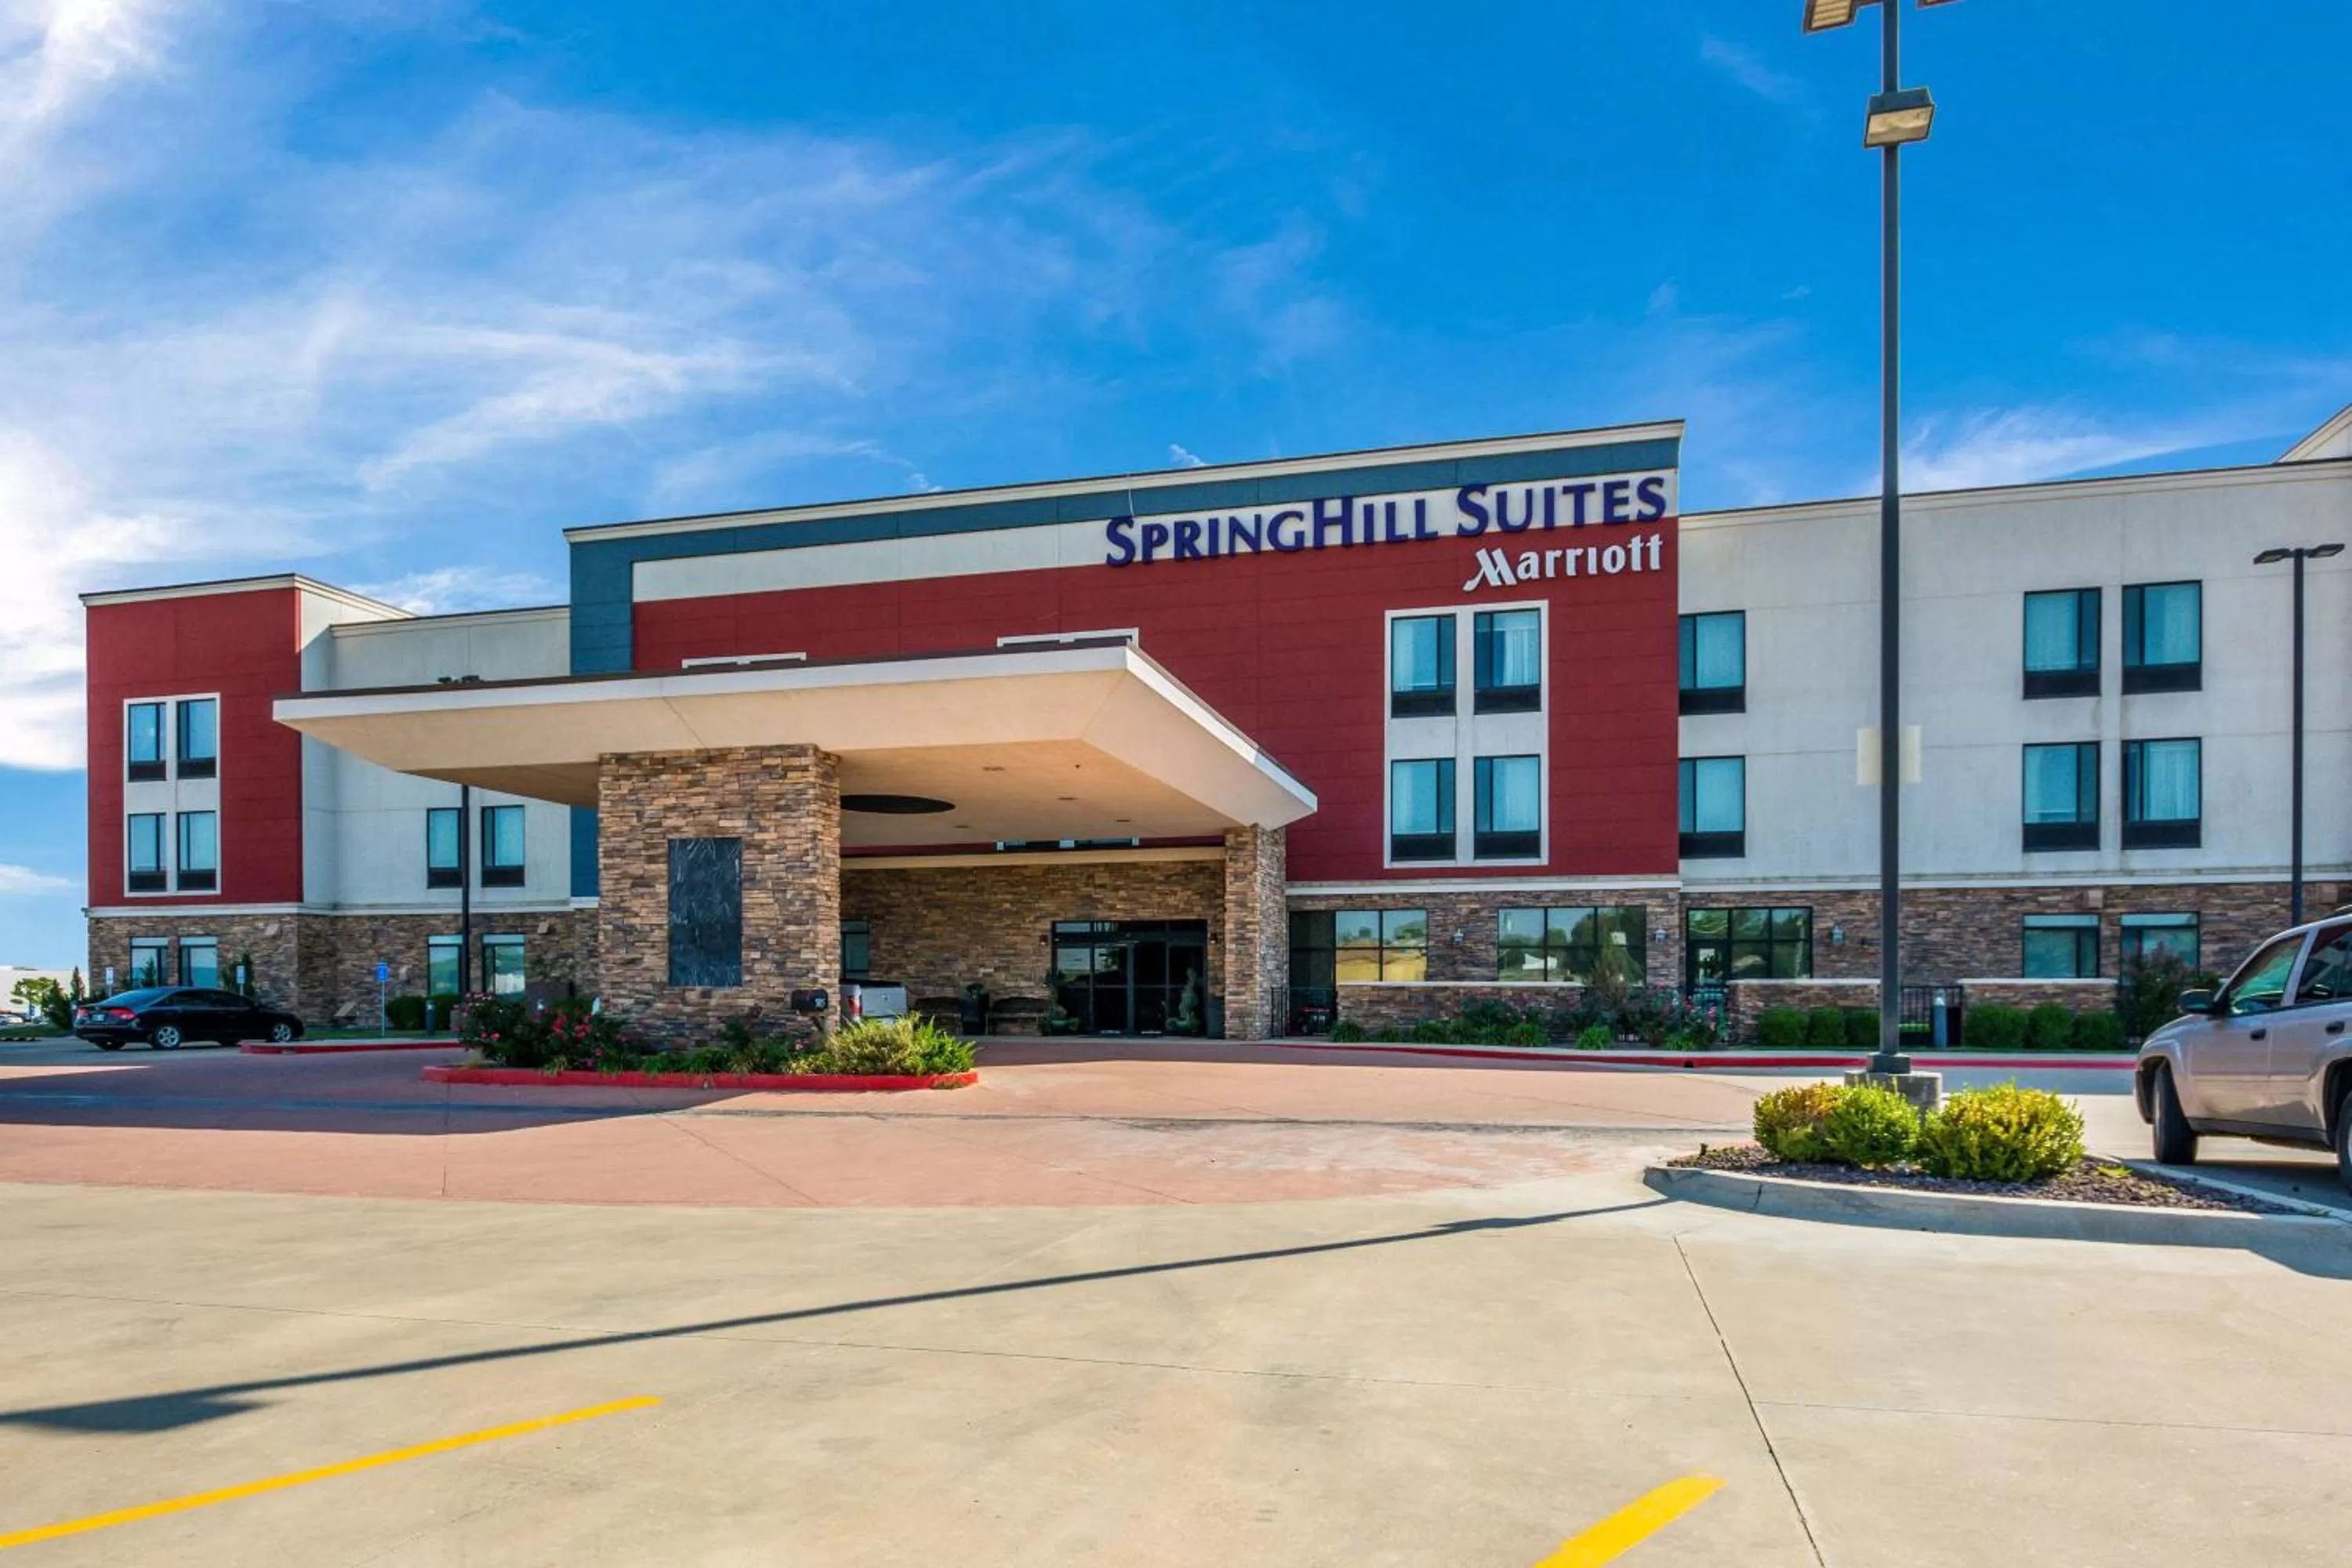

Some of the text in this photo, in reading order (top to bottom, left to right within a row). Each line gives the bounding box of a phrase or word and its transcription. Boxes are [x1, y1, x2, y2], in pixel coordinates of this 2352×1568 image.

[1105, 477, 1667, 568] SPRINGHILL SUITES
[1462, 533, 1663, 592] Marriott
